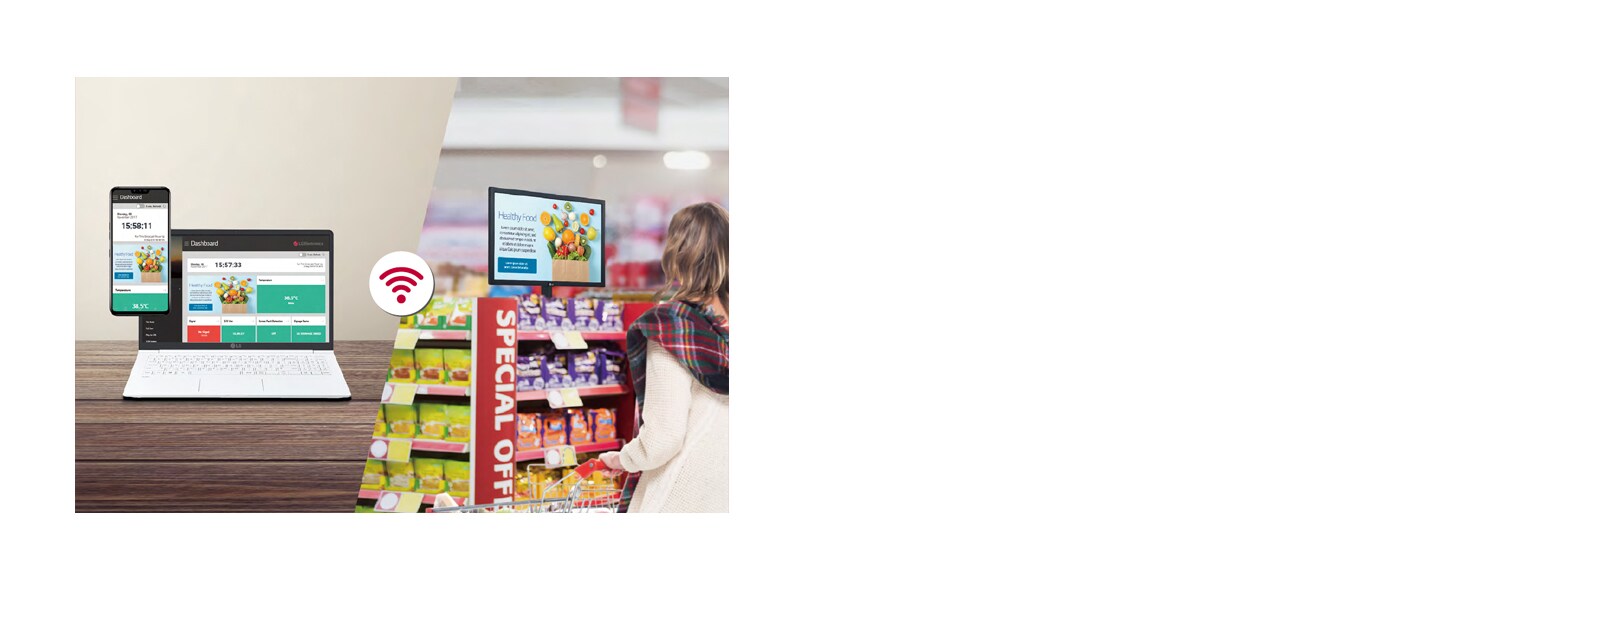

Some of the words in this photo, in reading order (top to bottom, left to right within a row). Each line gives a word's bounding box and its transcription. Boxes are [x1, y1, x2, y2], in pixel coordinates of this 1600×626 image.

[498, 211, 522, 222] Healthy
[522, 214, 537, 222] Food
[494, 310, 516, 430] SPECIAL
